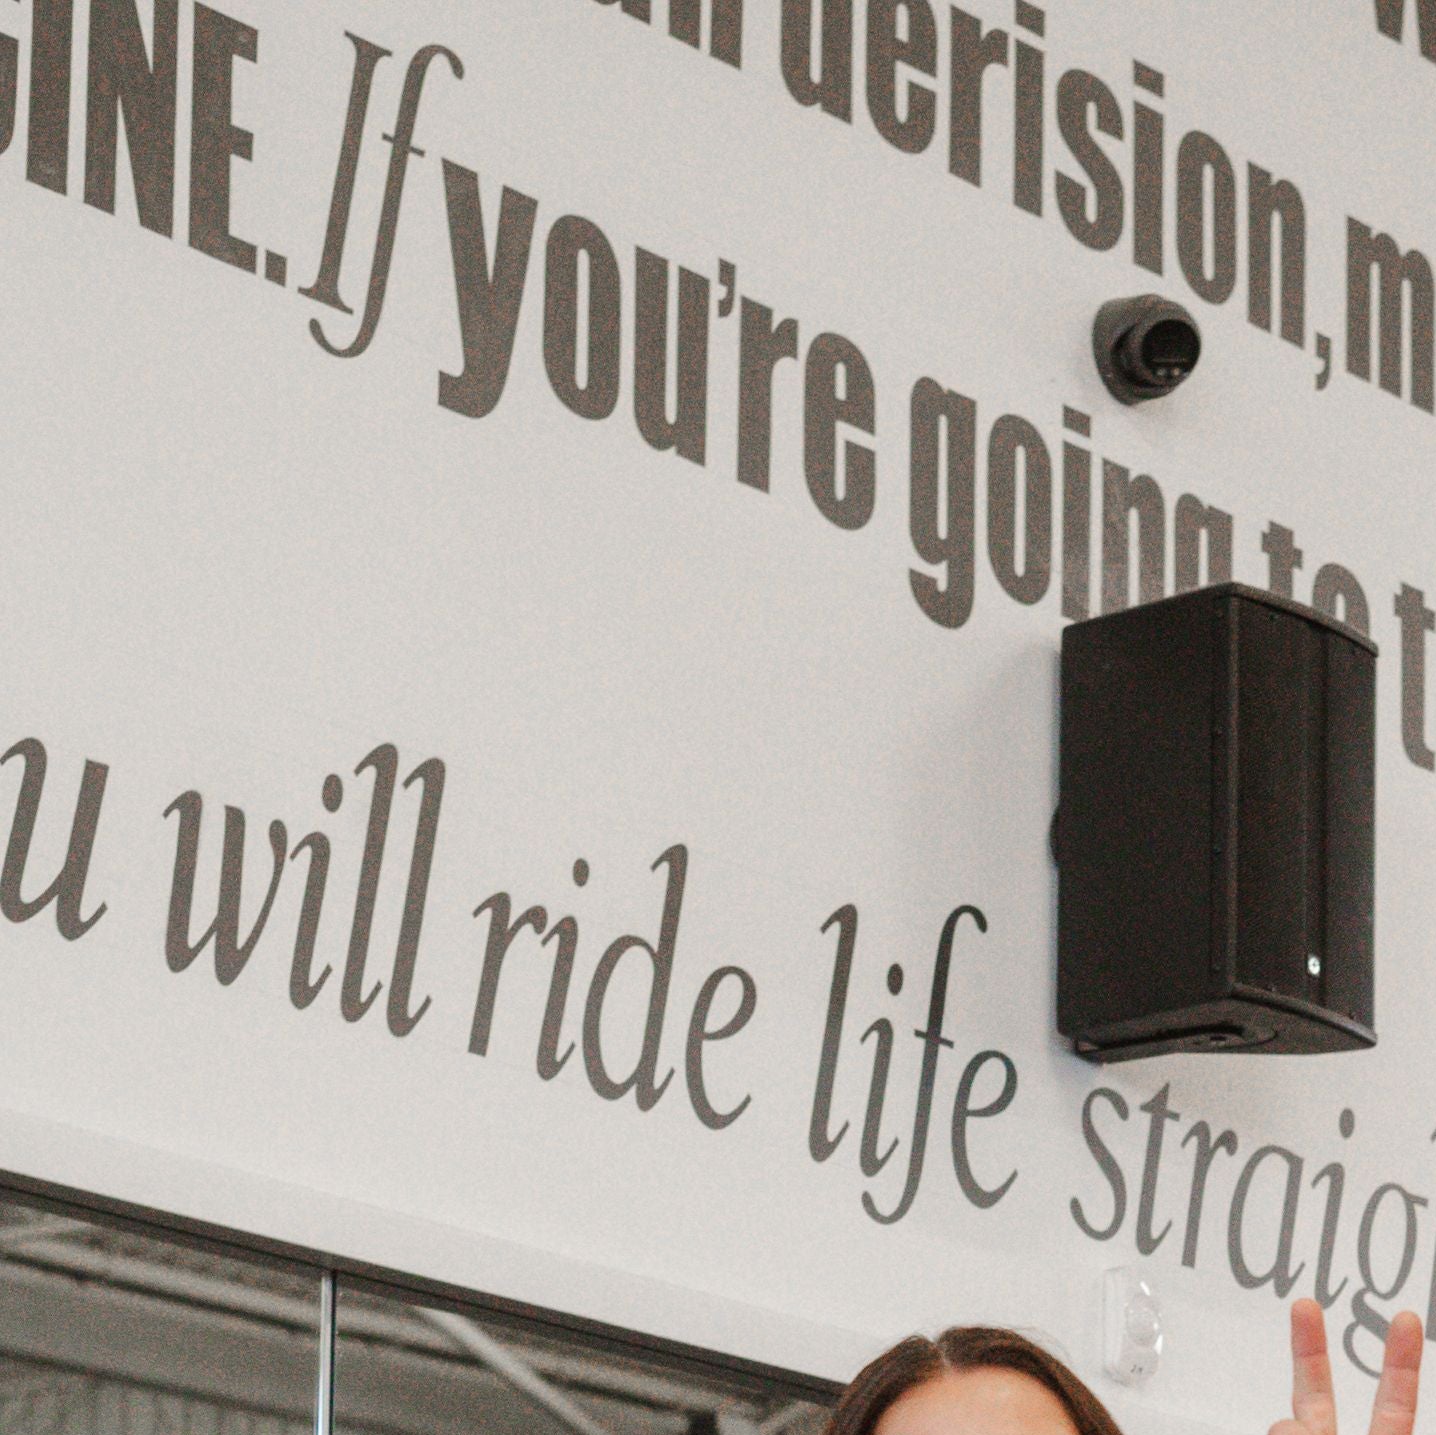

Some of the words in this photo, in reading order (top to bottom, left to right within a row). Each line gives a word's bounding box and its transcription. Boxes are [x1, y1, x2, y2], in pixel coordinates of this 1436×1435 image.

[298, 31, 465, 359] If
[437, 158, 877, 531] you're
[162, 742, 447, 1038] will
[468, 843, 758, 1130] ride
[808, 903, 1019, 1225] life
